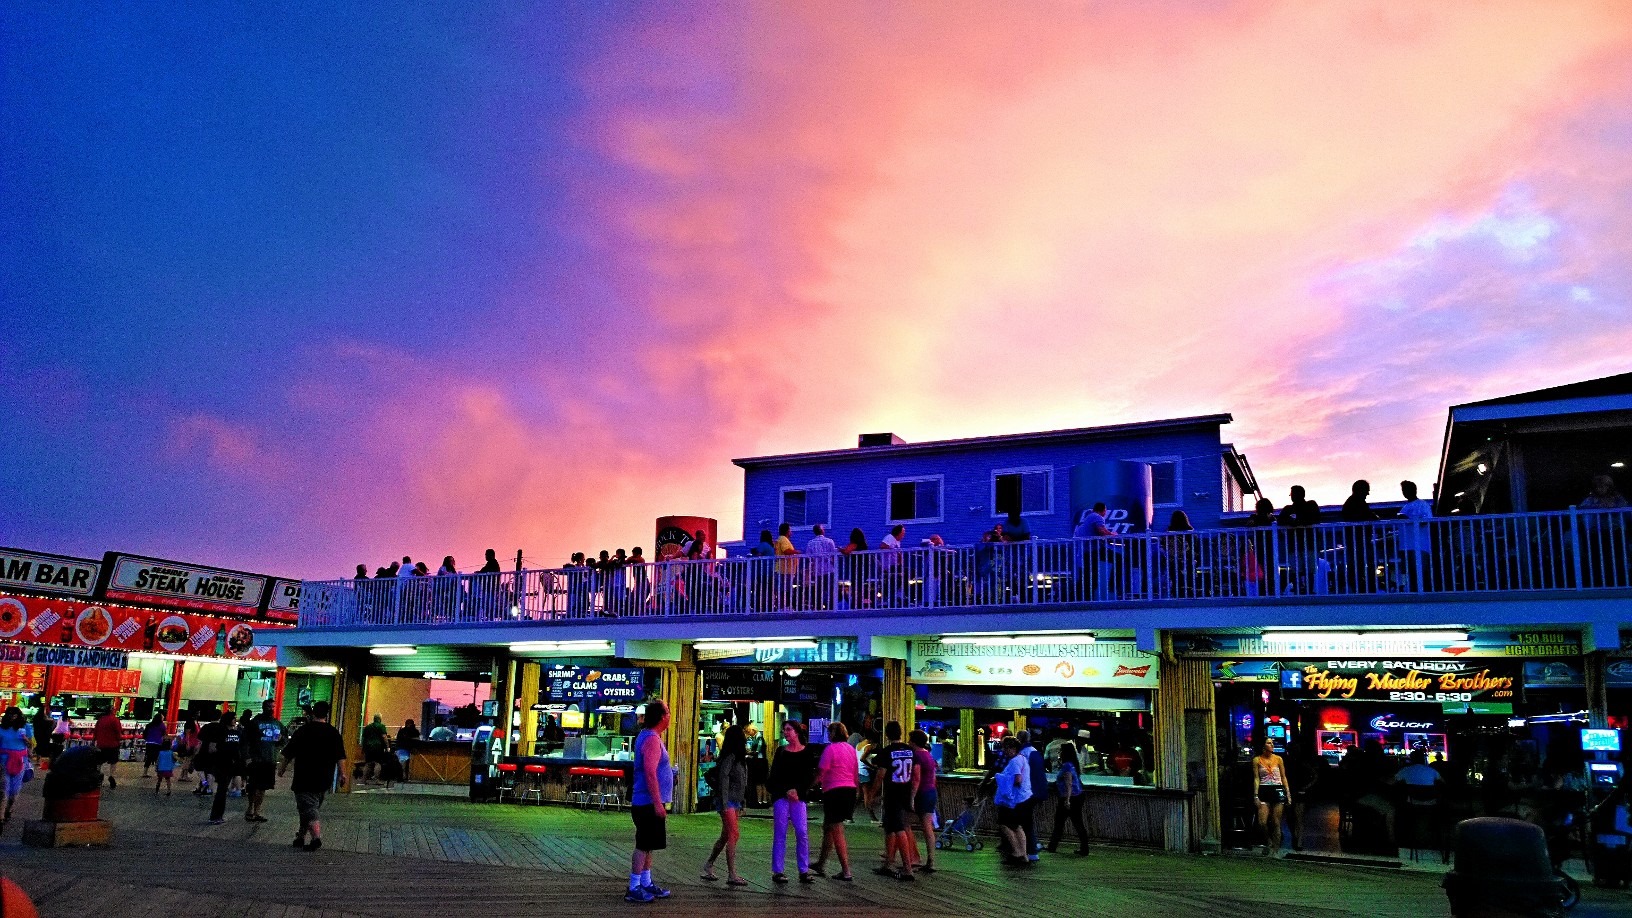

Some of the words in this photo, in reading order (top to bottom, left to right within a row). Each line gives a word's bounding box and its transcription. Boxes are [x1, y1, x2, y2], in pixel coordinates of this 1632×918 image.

[35, 563, 90, 589] BAR
[135, 568, 190, 594] STEAK
[194, 577, 246, 601] HOUSE
[1505, 645, 1536, 656] LIGHT
[1538, 645, 1579, 656] DRAFTS
[36, 647, 75, 665] GROUPER
[76, 650, 121, 668] SANDWICH
[1327, 660, 1378, 669] EVERY
[1383, 660, 1466, 671] SATURDAY
[548, 670, 576, 678] SHRIMP
[602, 673, 627, 682] CRABS
[752, 673, 775, 683] CLAMS
[572, 682, 598, 690] CLAMS
[603, 688, 635, 697] OYSTERS
[1304, 672, 1358, 698] Flying
[1365, 670, 1432, 690] Mueller
[1440, 669, 1514, 691] Brothers
[726, 686, 755, 695] OYSTERS
[1491, 689, 1513, 698] .com
[891, 758, 913, 783] 20
